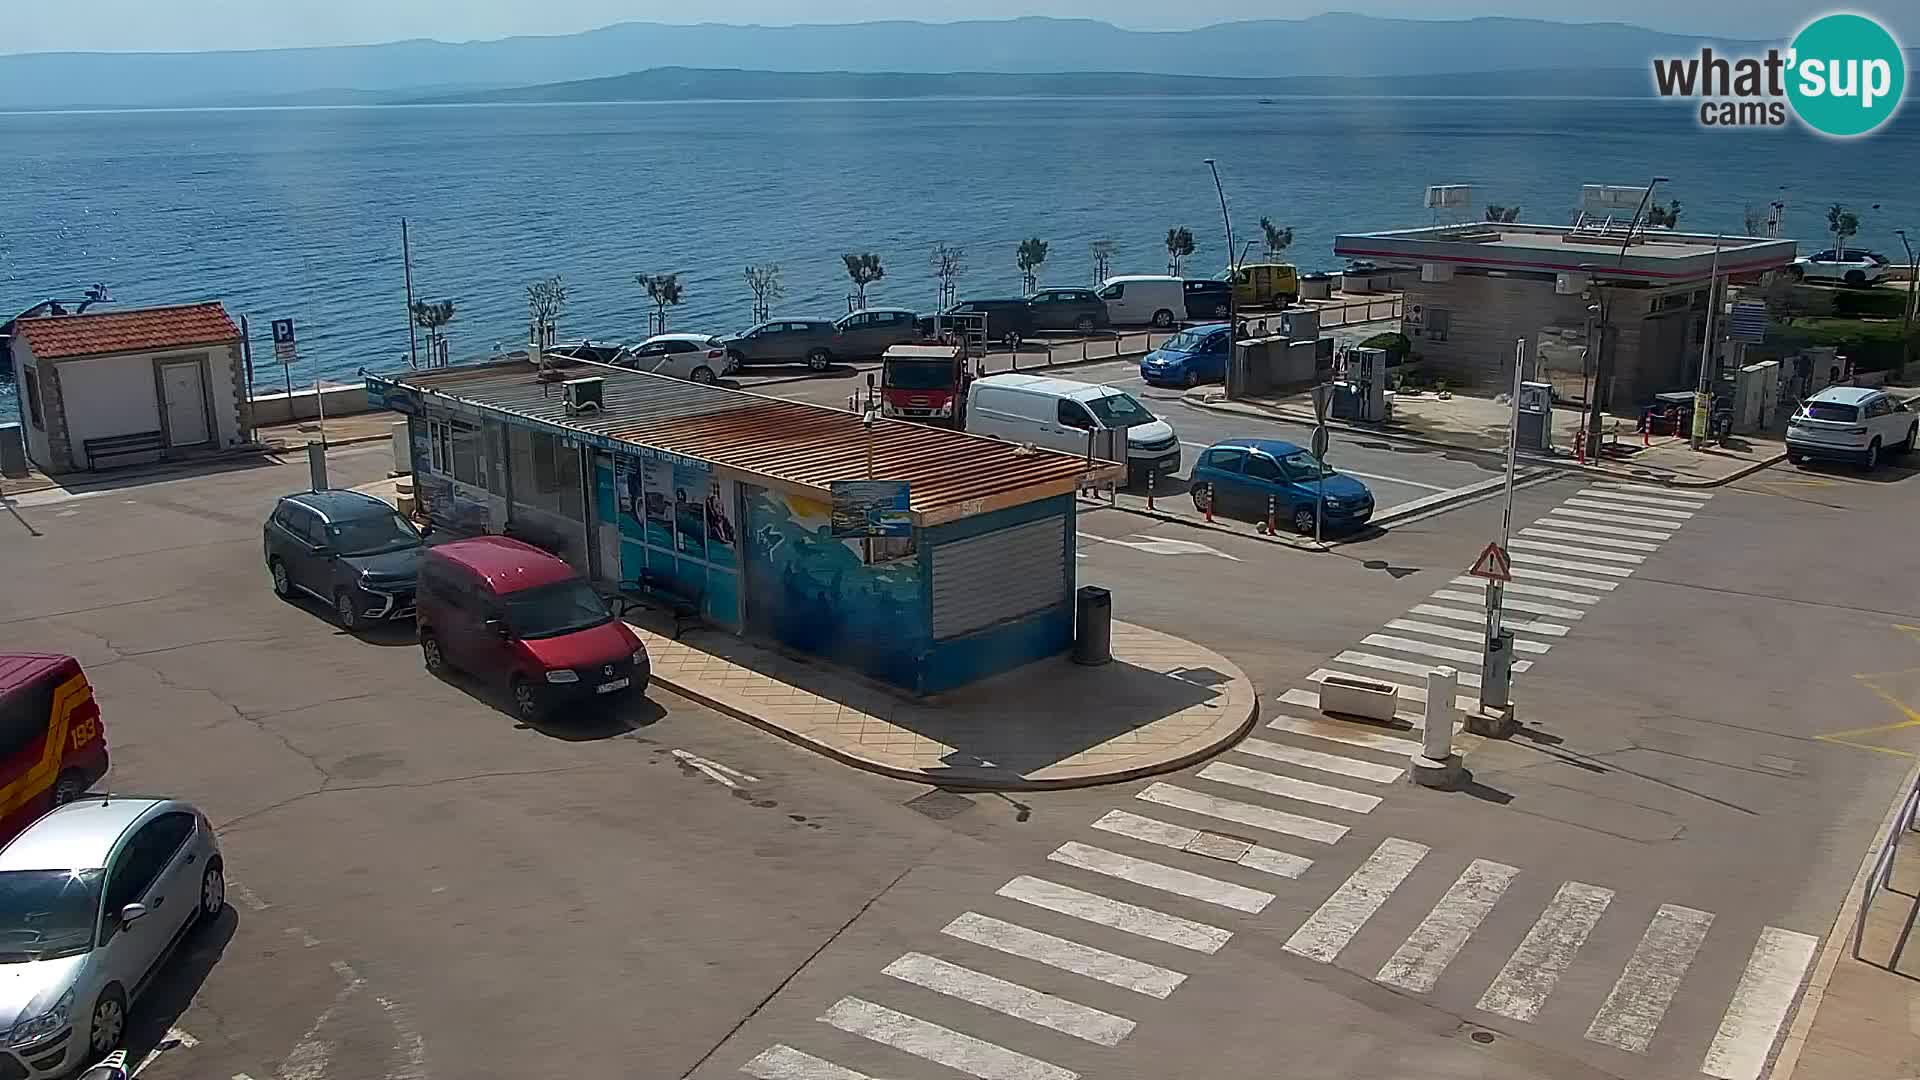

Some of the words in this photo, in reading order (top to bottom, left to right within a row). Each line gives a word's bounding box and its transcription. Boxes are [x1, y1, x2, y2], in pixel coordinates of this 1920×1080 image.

[277, 322, 288, 340] P
[607, 439, 621, 451] BUS
[623, 443, 655, 457] STATION
[657, 451, 682, 464] TICKET
[683, 457, 710, 471] OFFICE
[71, 718, 96, 749] 193
